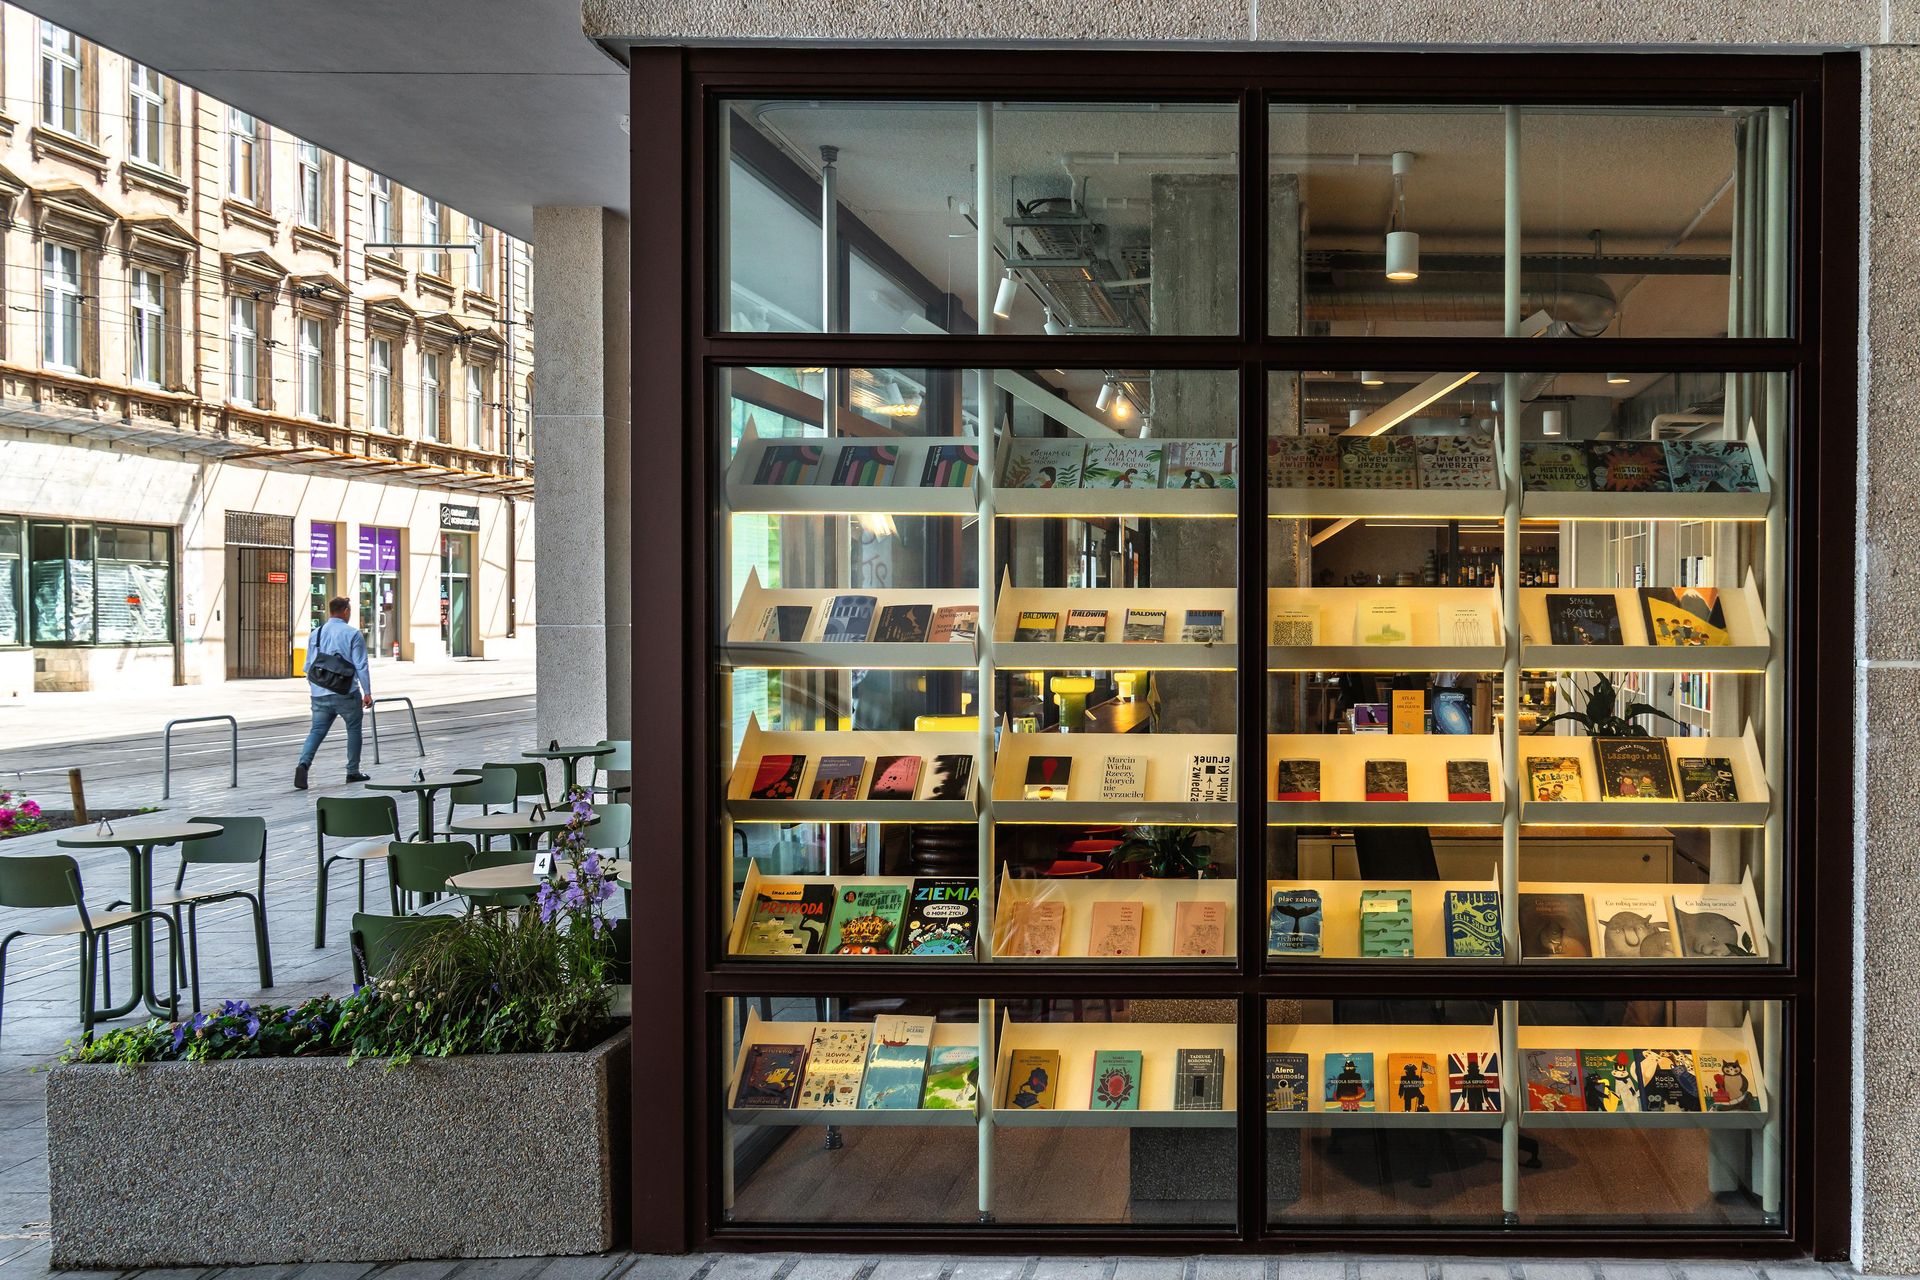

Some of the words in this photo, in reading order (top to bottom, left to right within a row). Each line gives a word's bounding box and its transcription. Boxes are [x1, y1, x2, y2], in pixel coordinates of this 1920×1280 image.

[1106, 449, 1144, 458] MAMA
[1022, 611, 1057, 619] BALDWIN
[539, 857, 546, 868] 4
[915, 887, 979, 901] ZIEMIA
[760, 902, 824, 915] PRZYRODA
[1454, 914, 1470, 922] ELIF
